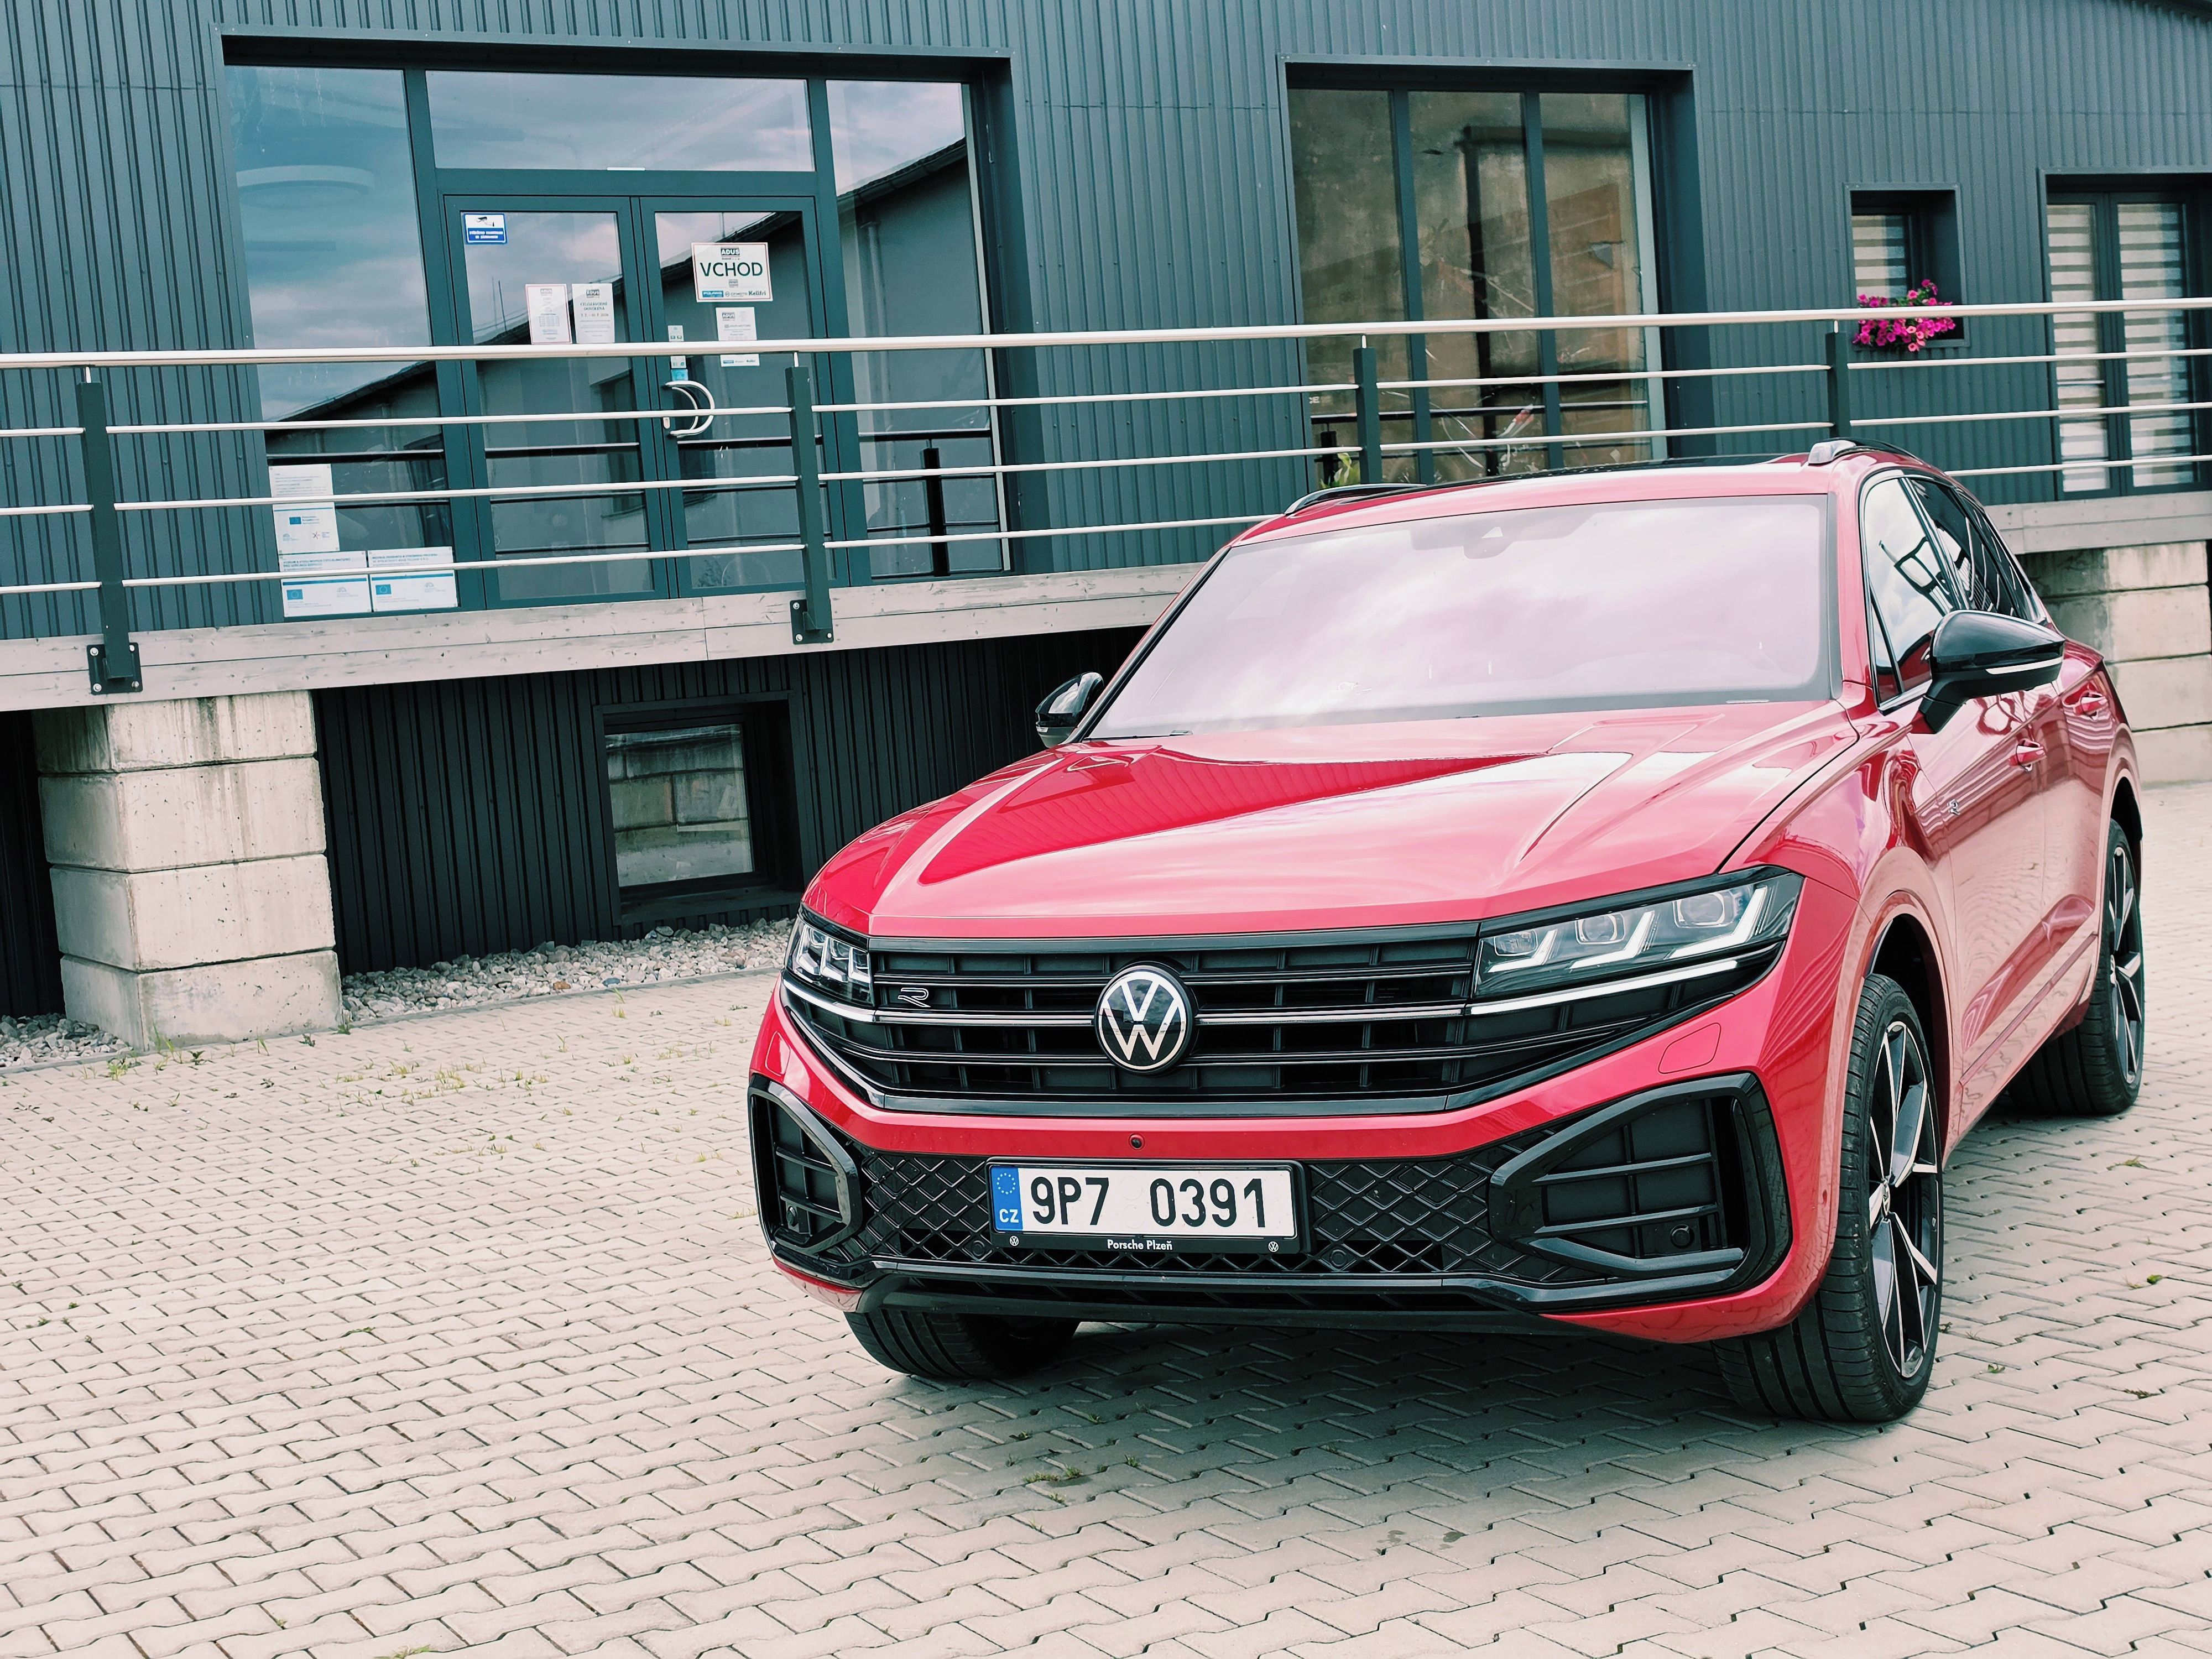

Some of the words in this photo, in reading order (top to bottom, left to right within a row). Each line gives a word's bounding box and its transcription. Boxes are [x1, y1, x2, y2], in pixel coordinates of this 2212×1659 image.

[700, 262, 763, 276] VCHOD
[898, 987, 931, 1008] R
[1099, 971, 1186, 1070] VW
[1030, 1176, 1109, 1225] 9P7
[1150, 1178, 1266, 1228] 0391
[999, 1208, 1019, 1223] CZ
[1107, 1239, 1144, 1250] Porsche
[1146, 1240, 1173, 1251] Plzeň
